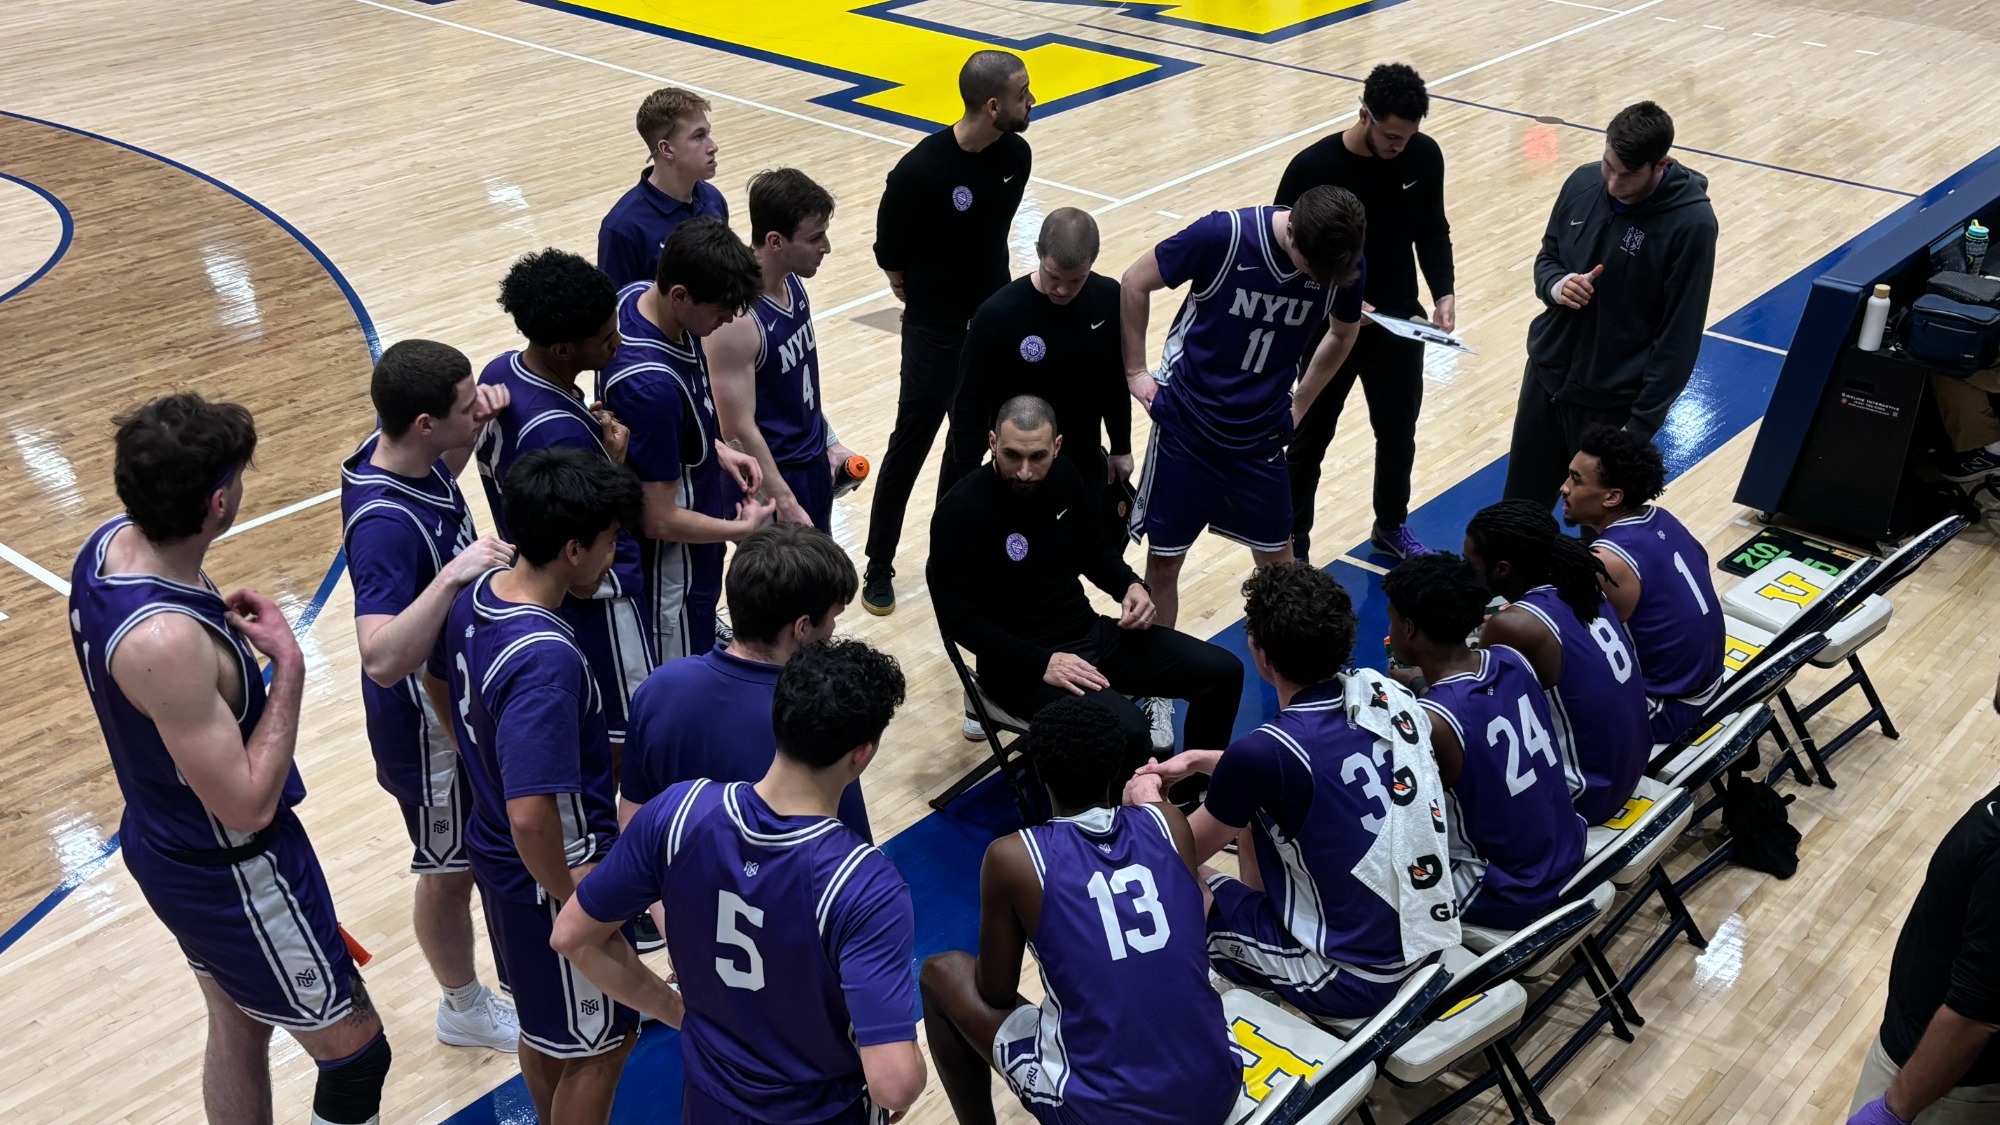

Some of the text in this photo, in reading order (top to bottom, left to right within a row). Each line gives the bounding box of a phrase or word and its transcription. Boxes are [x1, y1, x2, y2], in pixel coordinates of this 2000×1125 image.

[1228, 287, 1314, 326] NYU
[778, 319, 815, 374] NYU
[1240, 328, 1276, 373] 11
[802, 363, 815, 411] 4
[1674, 551, 1710, 616] 1
[1588, 617, 1632, 685] 8
[1486, 693, 1557, 797] 24
[715, 889, 765, 992] 5
[1087, 863, 1171, 961] 13
